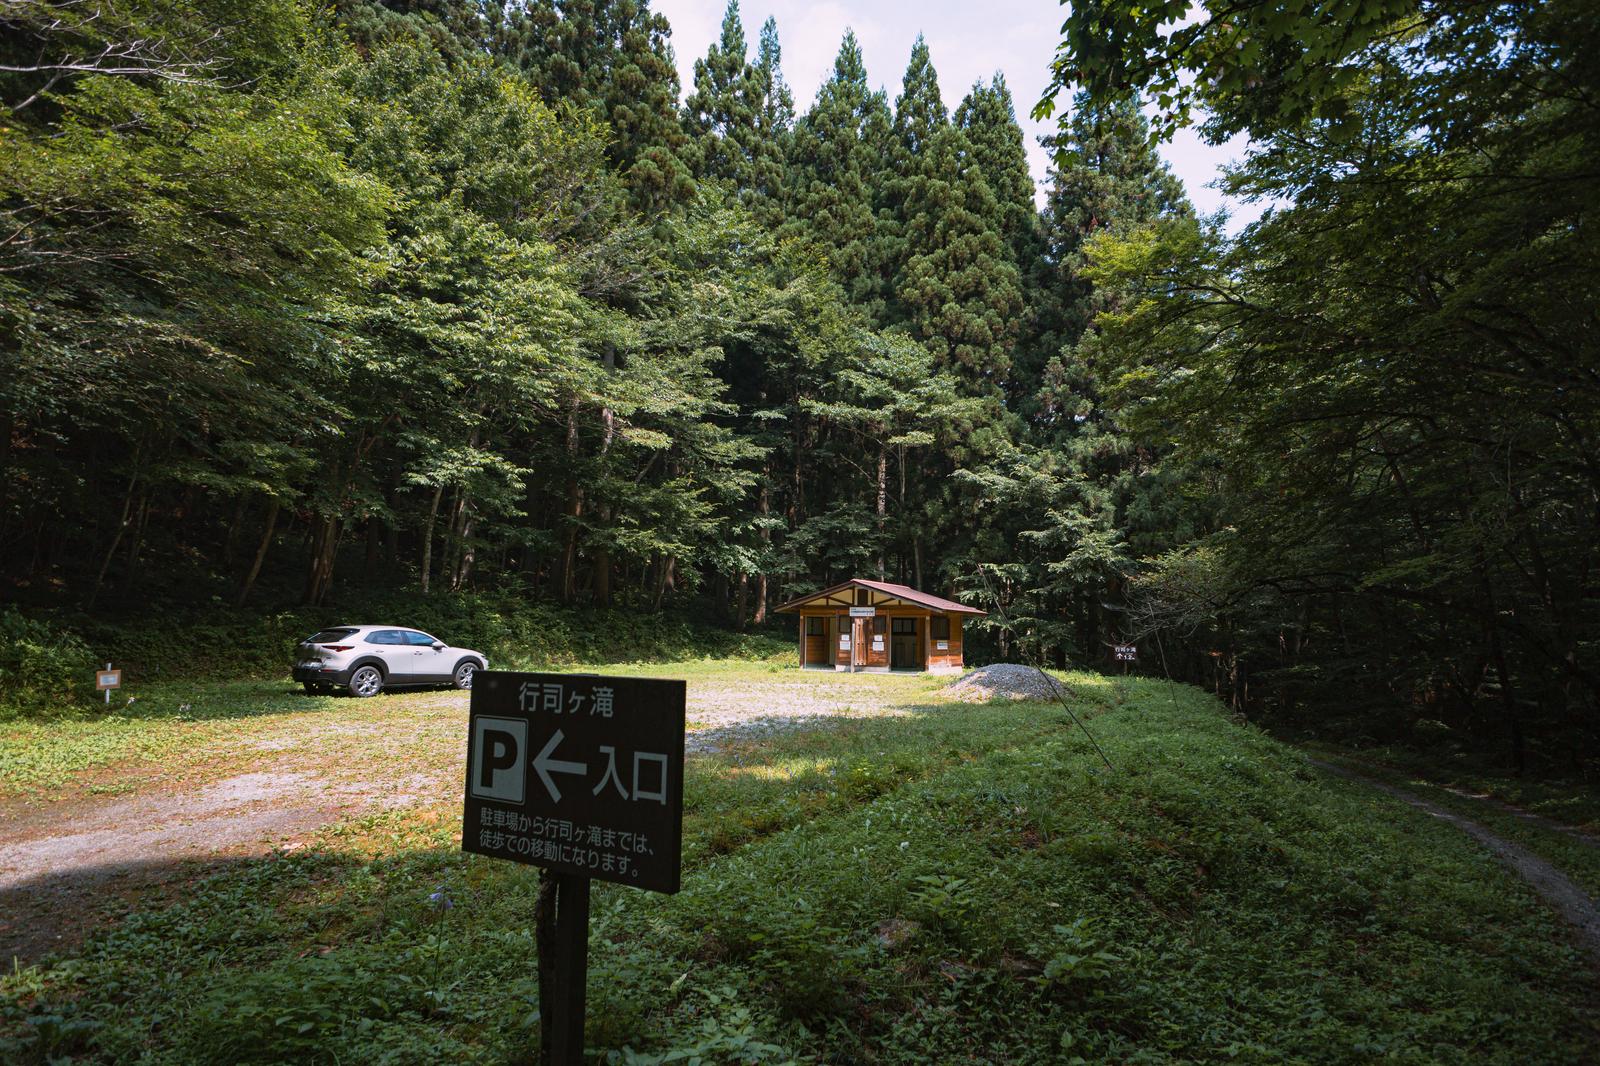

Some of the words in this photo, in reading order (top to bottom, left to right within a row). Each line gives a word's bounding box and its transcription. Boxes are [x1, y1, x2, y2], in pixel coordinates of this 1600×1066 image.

[519, 681, 614, 718] 行司ヶ滝
[481, 728, 518, 788] P
[592, 745, 668, 805] 入口
[479, 828, 639, 878] 徒歩での移動になります。
[480, 807, 655, 856] 駐車場から行司ヶ滝までは、
